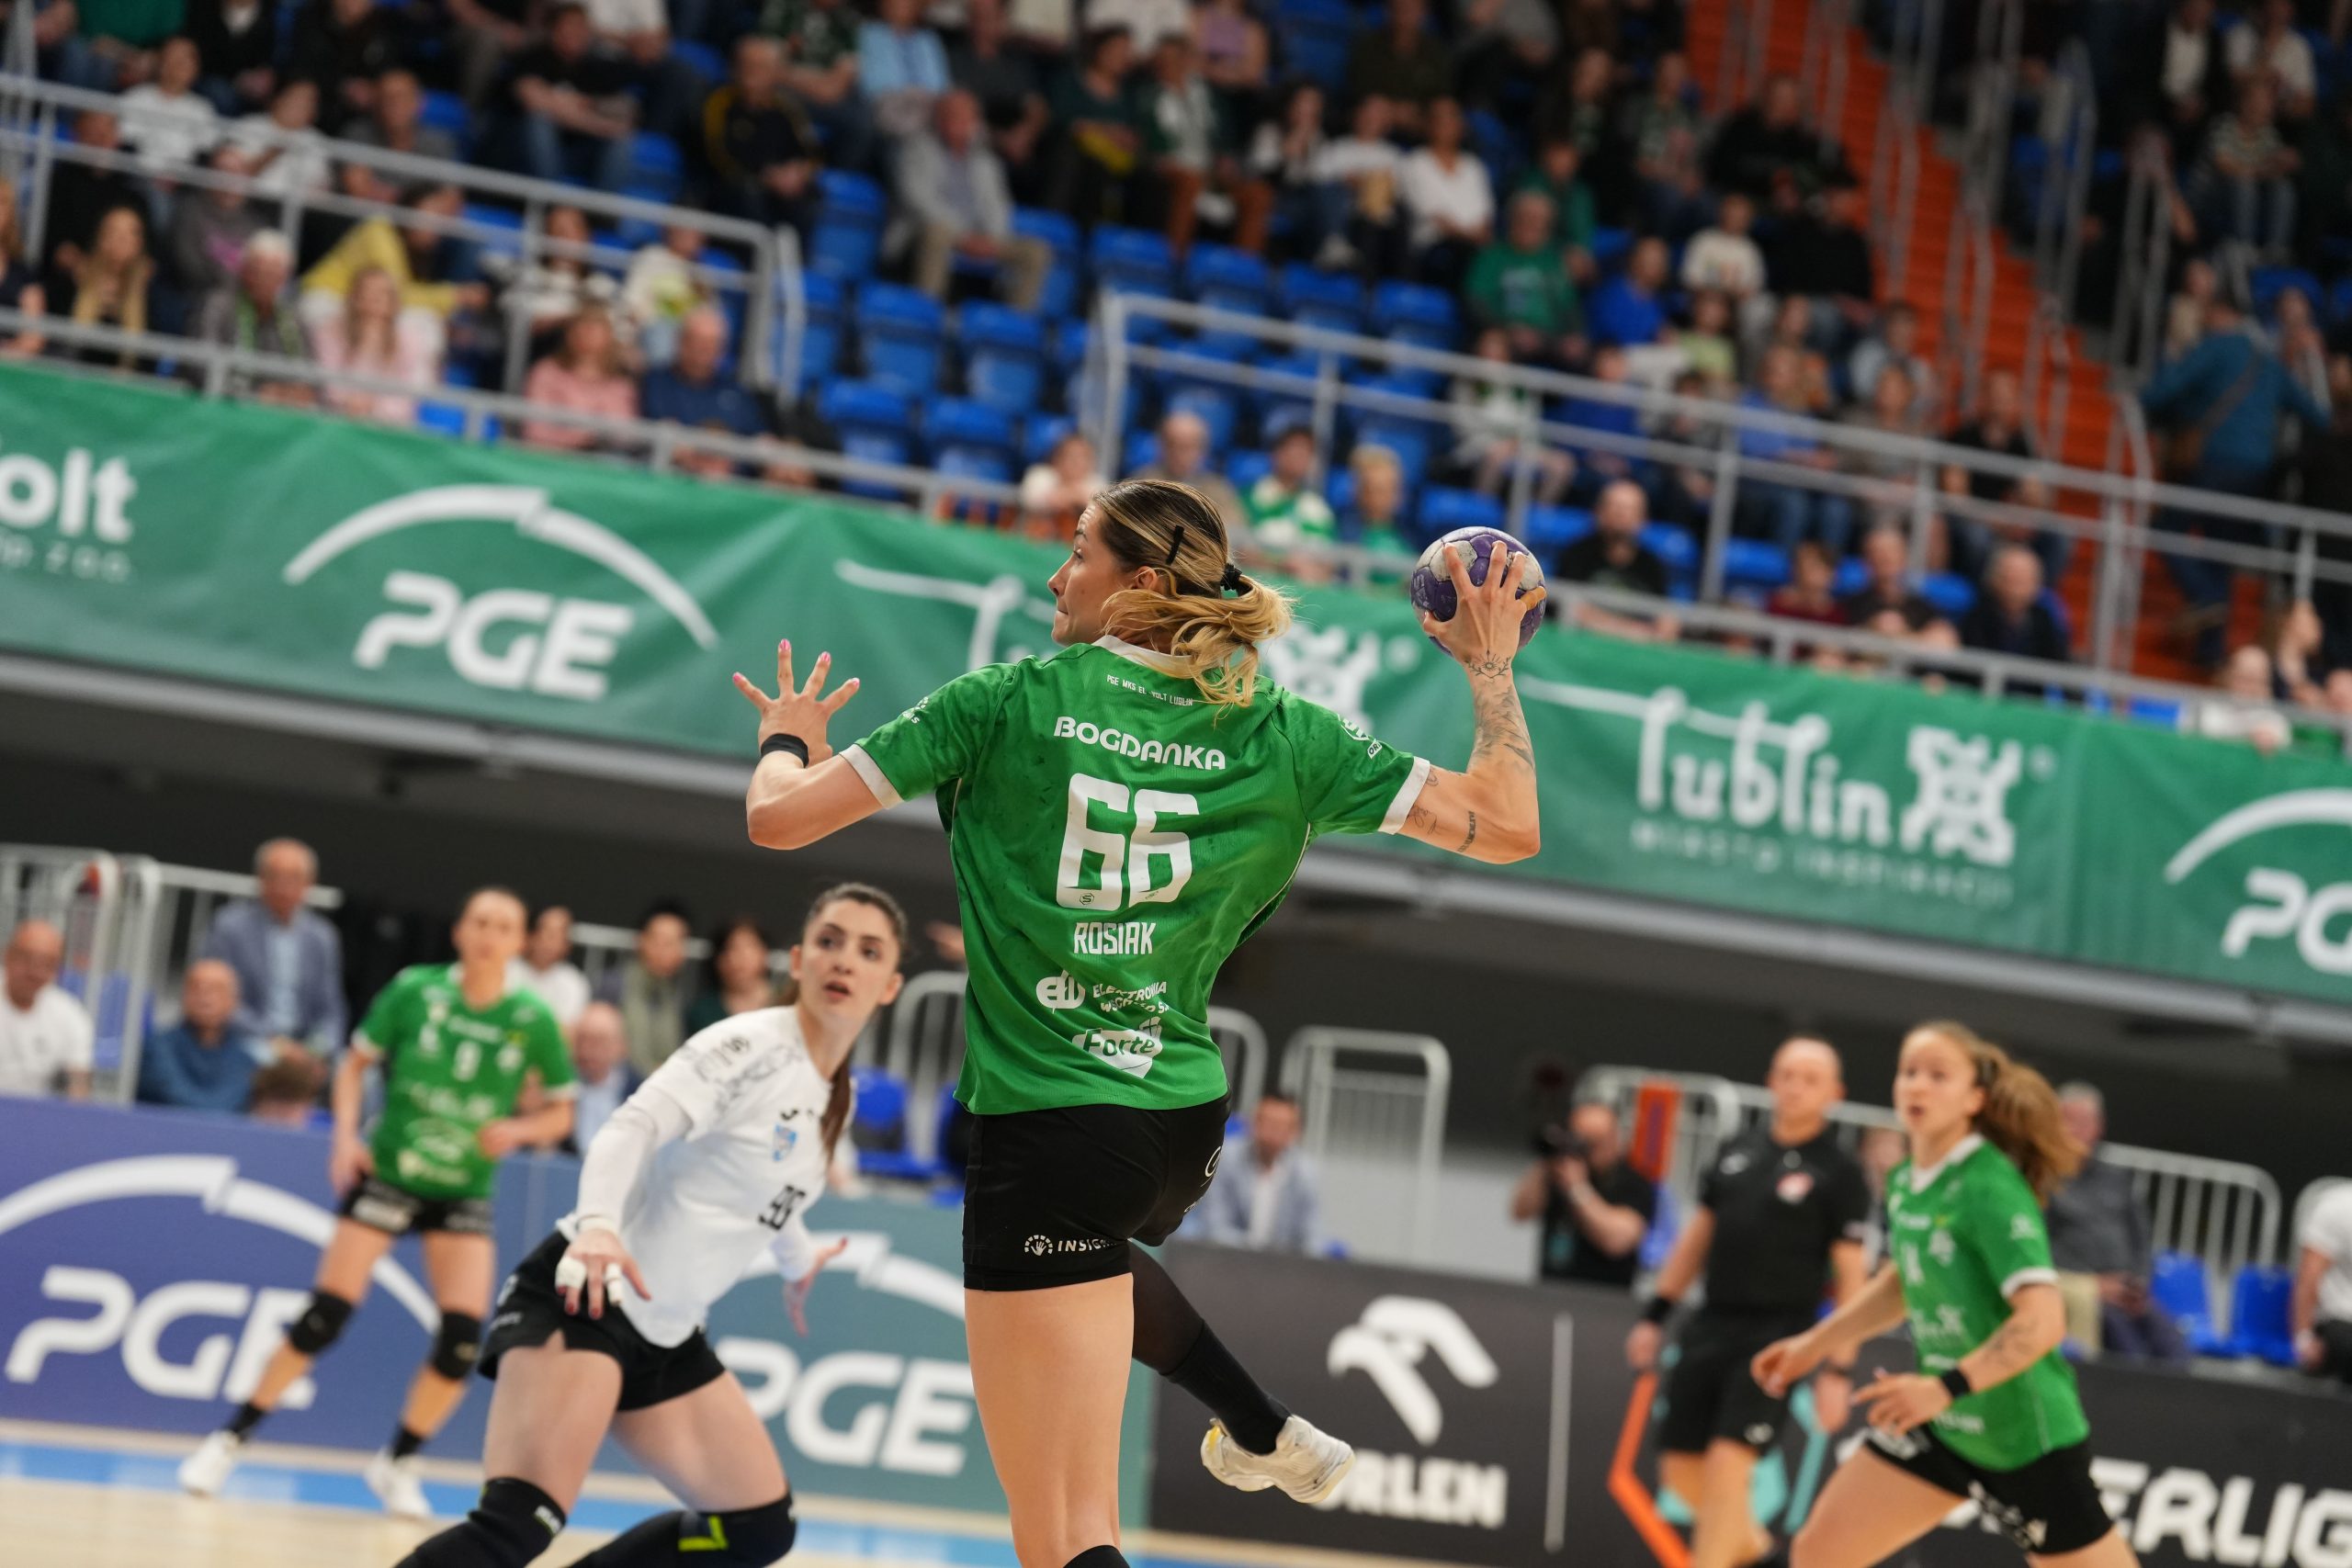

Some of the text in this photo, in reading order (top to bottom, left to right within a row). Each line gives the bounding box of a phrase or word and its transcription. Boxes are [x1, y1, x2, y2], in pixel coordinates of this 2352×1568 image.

[353, 570, 635, 700] PGE
[1106, 674, 1119, 686] PGE
[1122, 679, 1136, 691] MKS
[1053, 716, 1227, 771] BOGDANKA
[1056, 773, 1200, 911] 66
[1073, 921, 1157, 954] ROSIAK
[1082, 1028, 1156, 1057] Forte
[1309, 1448, 1508, 1529] RLEN
